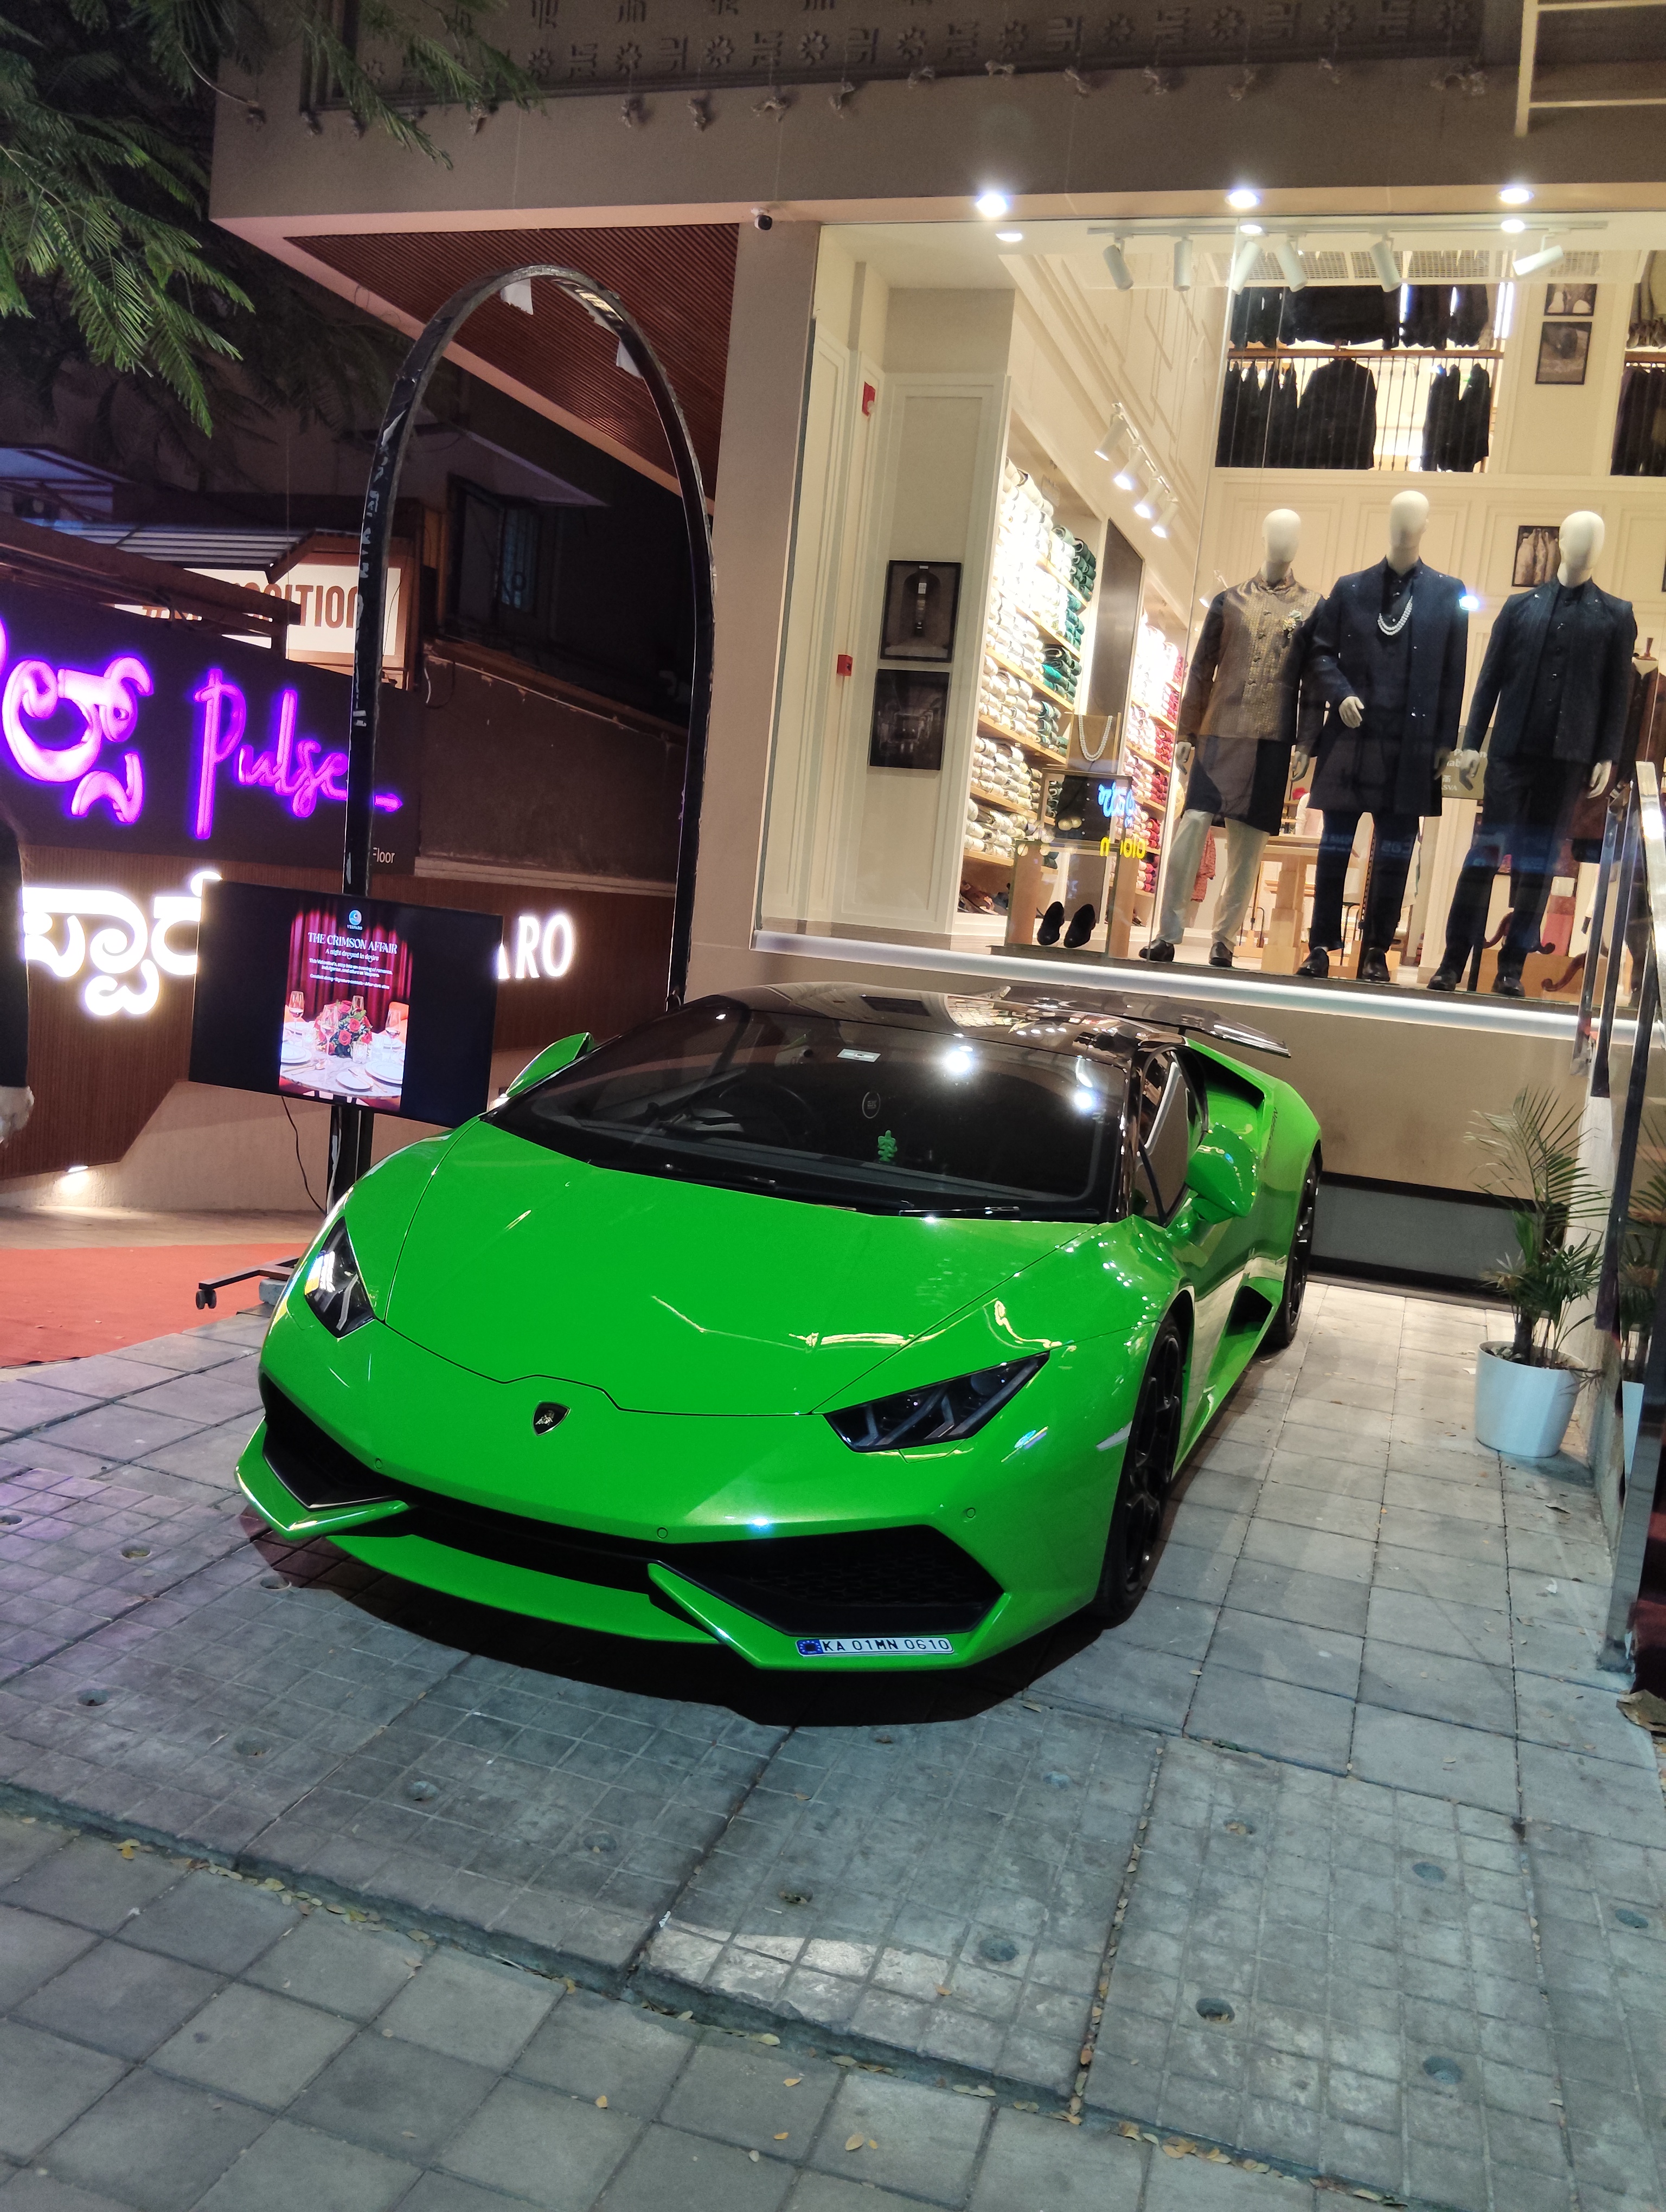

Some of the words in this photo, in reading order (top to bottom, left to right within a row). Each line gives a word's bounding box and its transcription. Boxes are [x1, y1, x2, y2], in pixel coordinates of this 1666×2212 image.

[194, 668, 402, 839] Pulse
[307, 931, 326, 944] THE
[326, 934, 368, 950] CRIMSON
[368, 941, 398, 954] AFFAIR
[498, 915, 573, 979] RO
[342, 950, 360, 960] dressed
[364, 954, 380, 963] desire
[822, 1640, 846, 1652] KA
[904, 1638, 950, 1651] 0610
